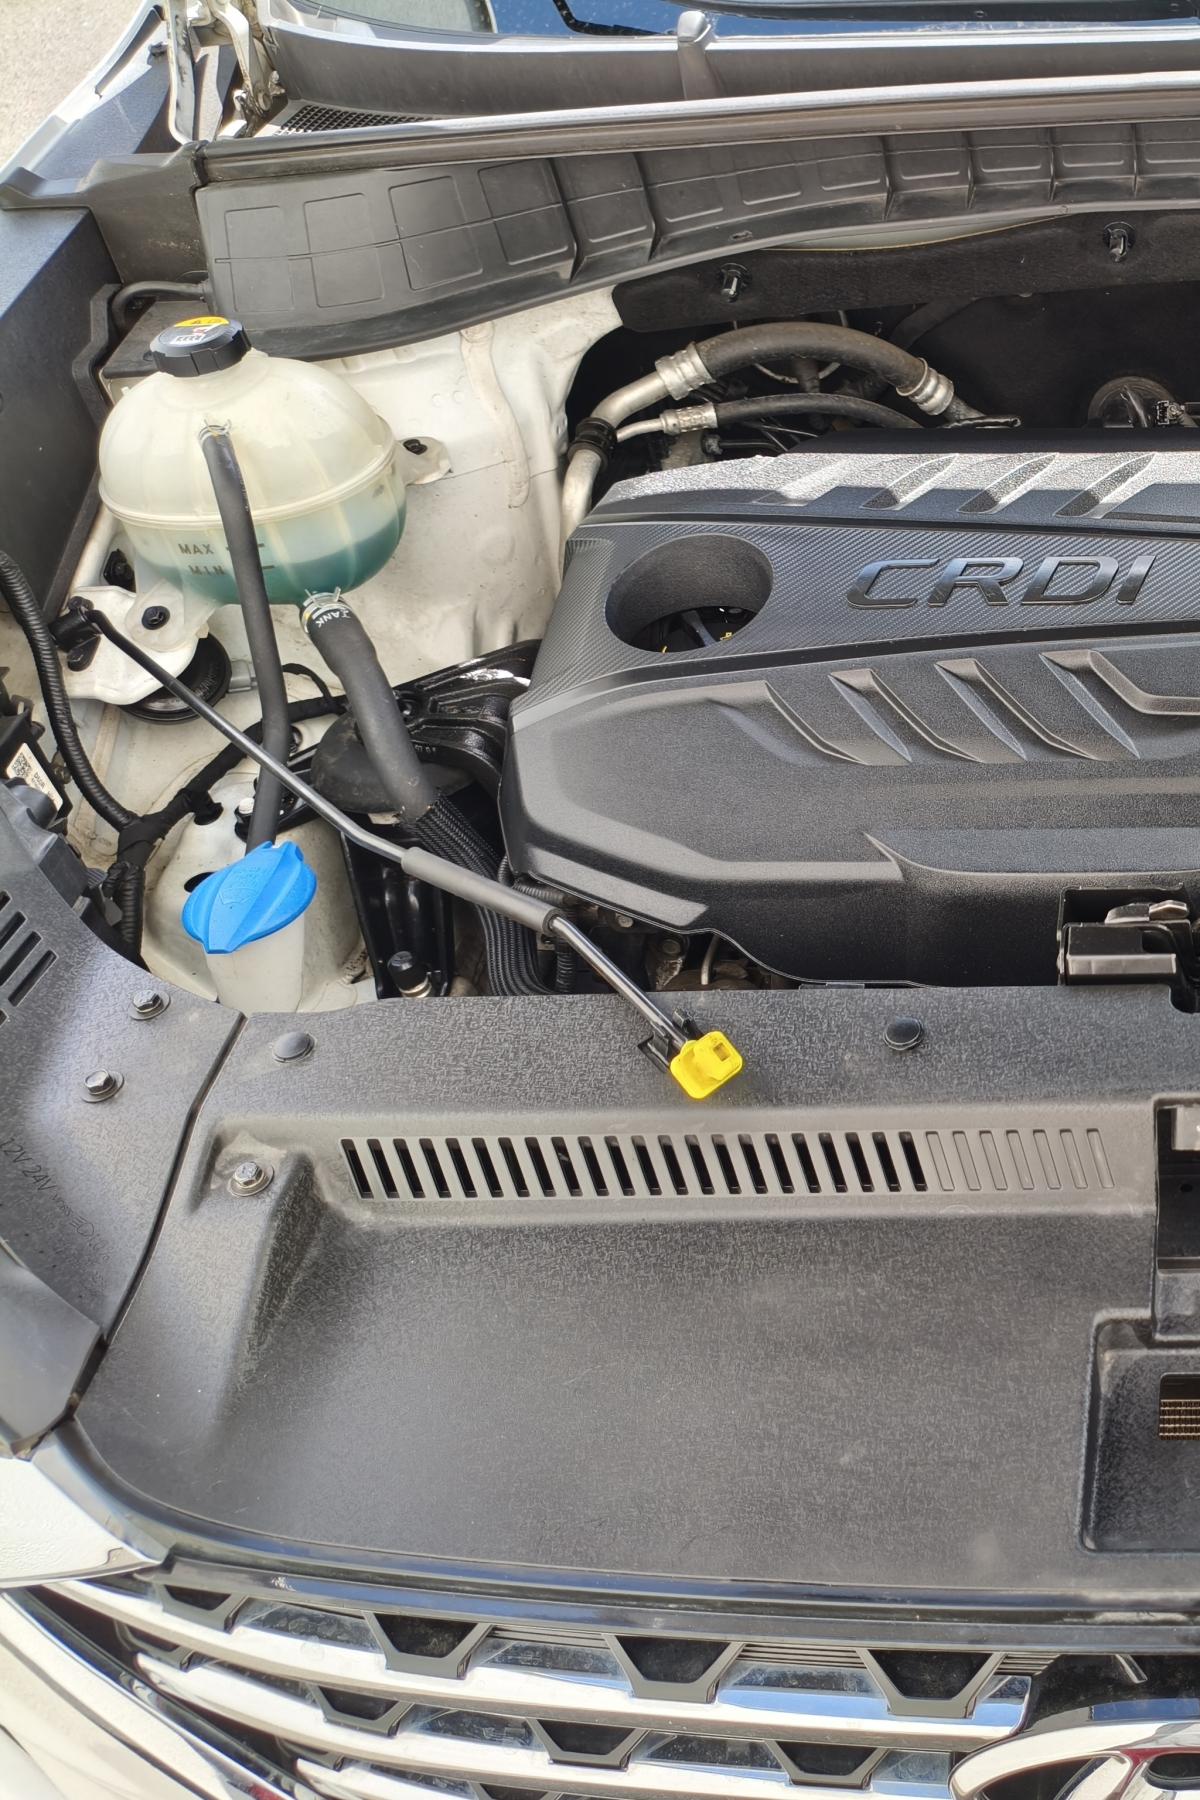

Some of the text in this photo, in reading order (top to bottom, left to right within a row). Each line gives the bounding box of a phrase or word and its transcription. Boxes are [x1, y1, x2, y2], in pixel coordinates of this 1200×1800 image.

[178, 543, 215, 555] MAX
[188, 565, 225, 576] MIN
[846, 555, 1157, 610] CRDI
[315, 608, 351, 629] TANK
[0, 1138, 33, 1163] 12V
[22, 1165, 57, 1191] 24V
